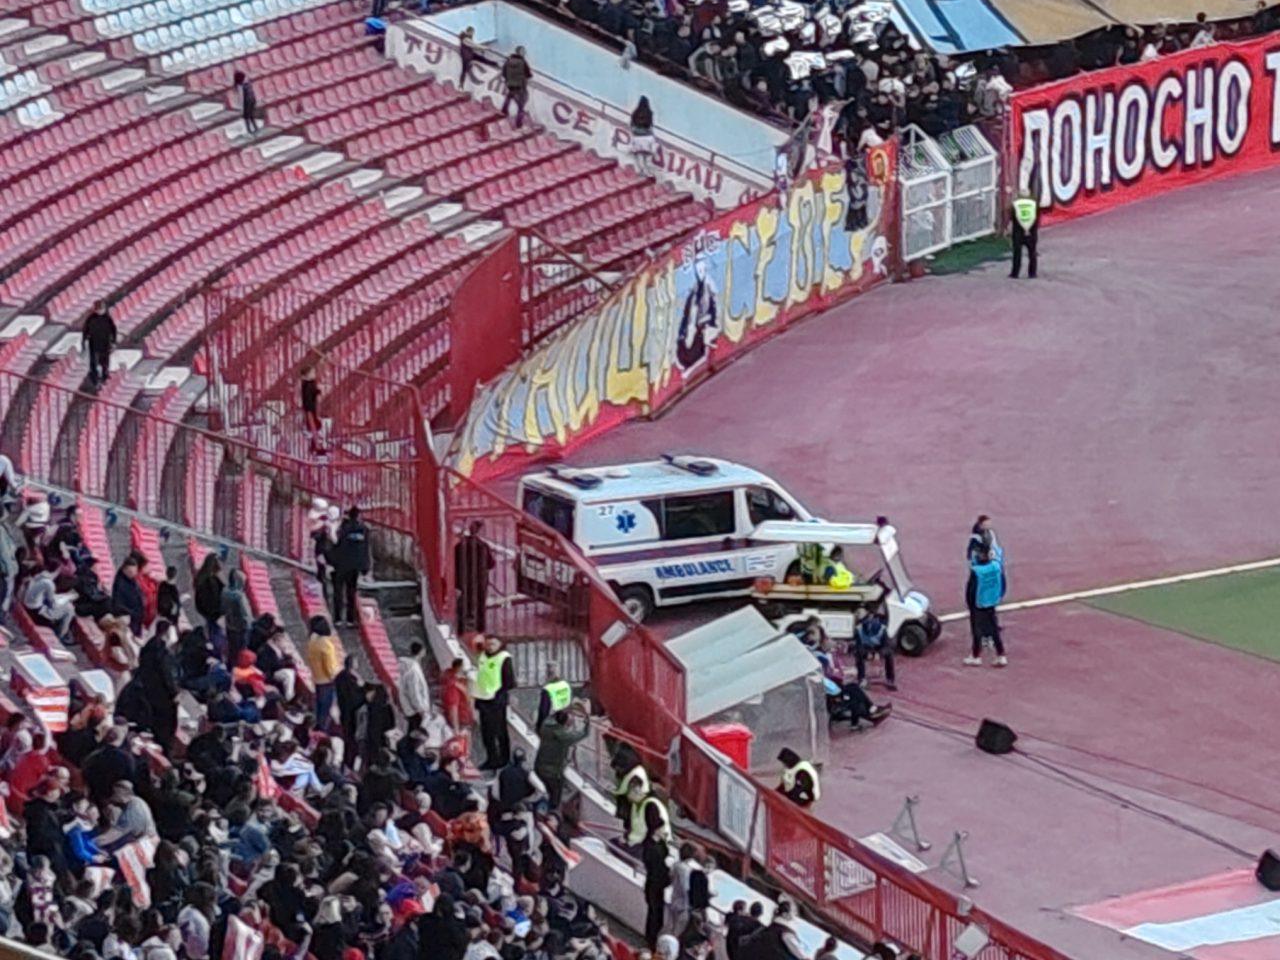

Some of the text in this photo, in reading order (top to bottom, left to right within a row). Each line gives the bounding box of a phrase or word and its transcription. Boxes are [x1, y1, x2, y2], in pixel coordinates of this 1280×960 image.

[552, 101, 596, 136] СЕ
[1019, 59, 1251, 208] ПОНОСНО
[654, 559, 735, 579] AMBULANCE
